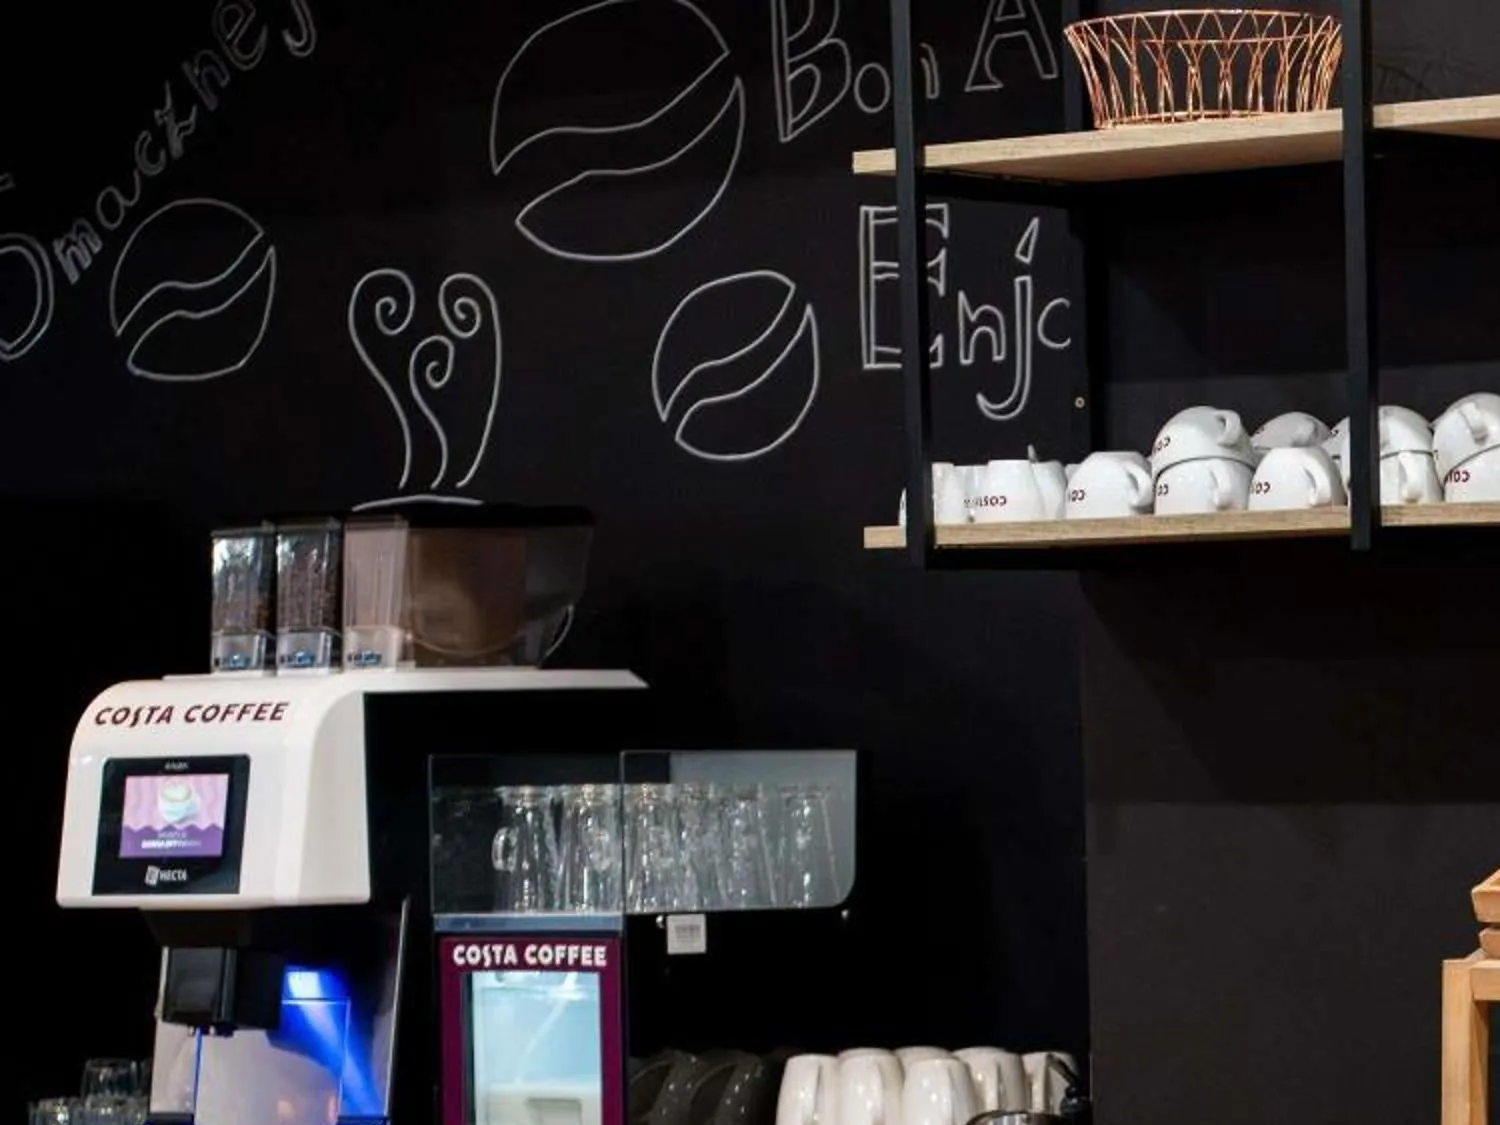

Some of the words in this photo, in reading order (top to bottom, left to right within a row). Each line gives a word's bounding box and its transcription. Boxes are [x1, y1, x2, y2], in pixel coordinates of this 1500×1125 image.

[94, 704, 175, 728] COSTA
[183, 702, 290, 724] COFFEE
[452, 943, 519, 968] COSTA
[524, 943, 608, 967] COFFEE
